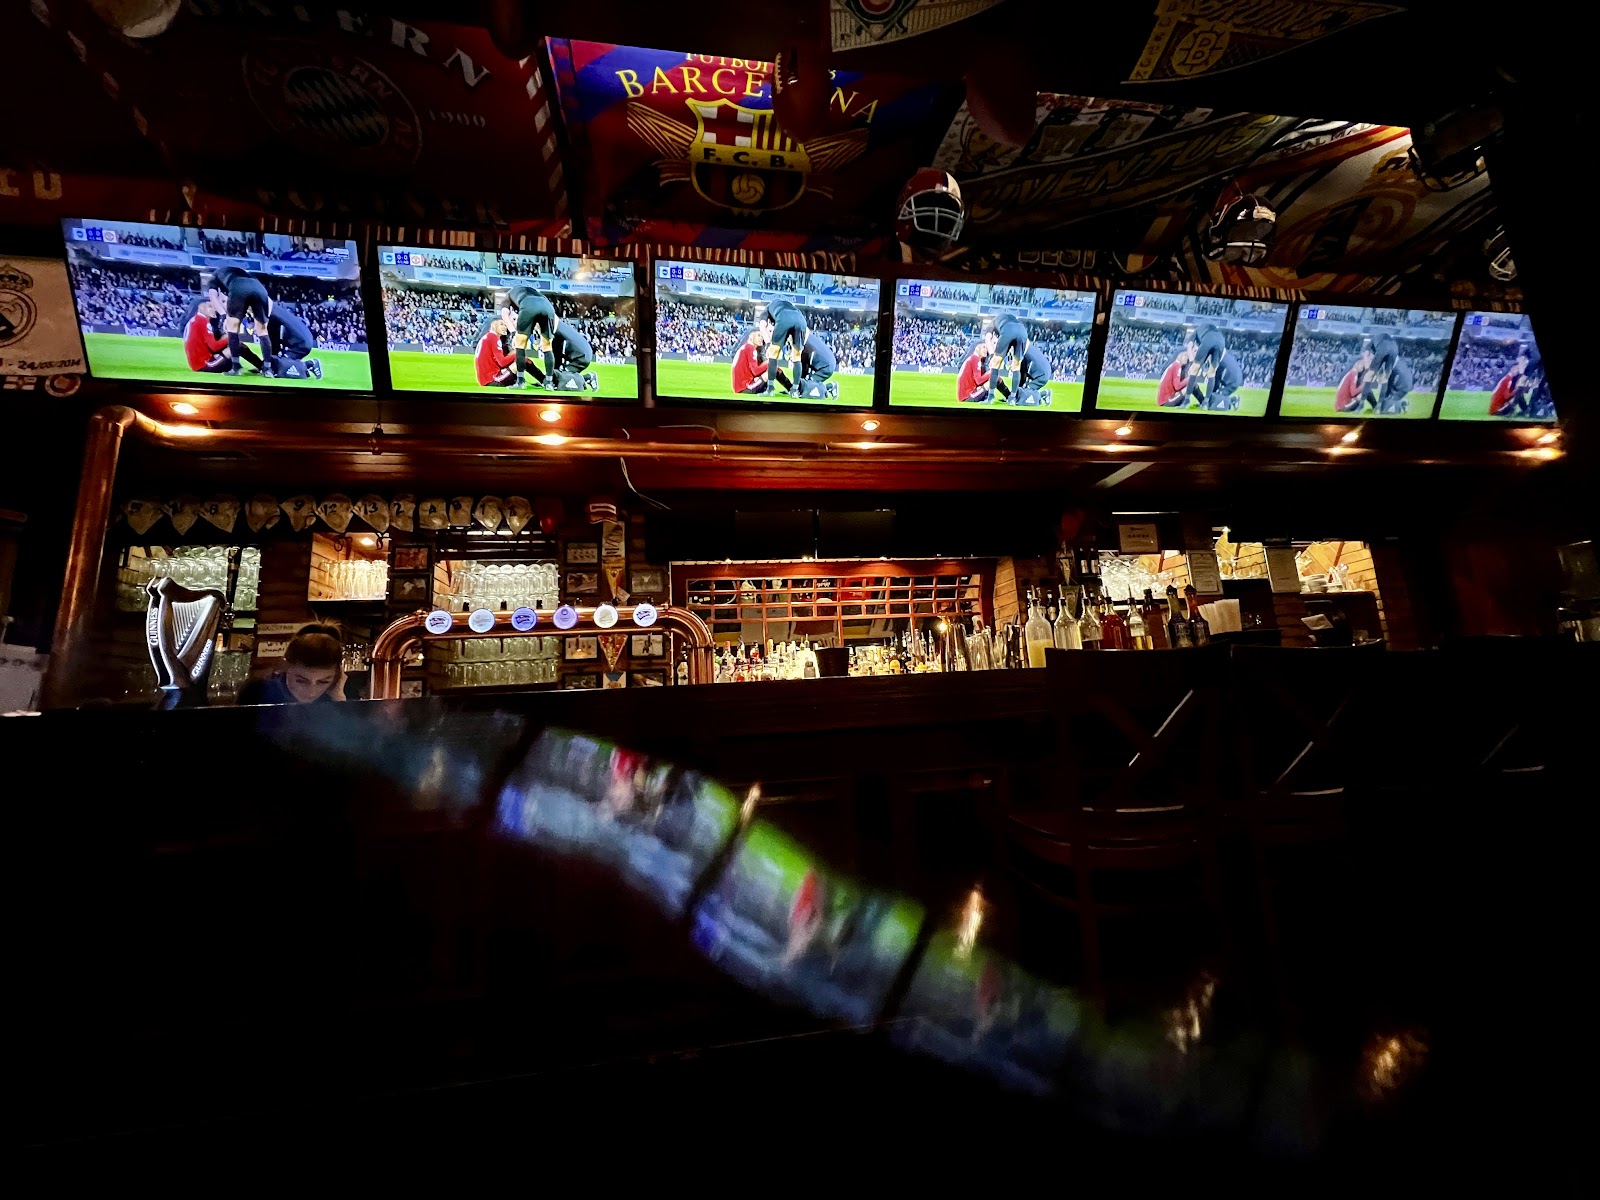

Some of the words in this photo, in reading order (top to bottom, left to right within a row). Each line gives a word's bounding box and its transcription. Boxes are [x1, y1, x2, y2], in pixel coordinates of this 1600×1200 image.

[615, 66, 878, 124] BARCENA
[317, 339, 351, 351] betway
[422, 343, 454, 354] betway
[595, 354, 627, 365] betway
[687, 352, 715, 364] betway
[839, 365, 865, 375] betway
[149, 607, 160, 647] GUINNESS
[191, 638, 213, 678] GUINNESS
